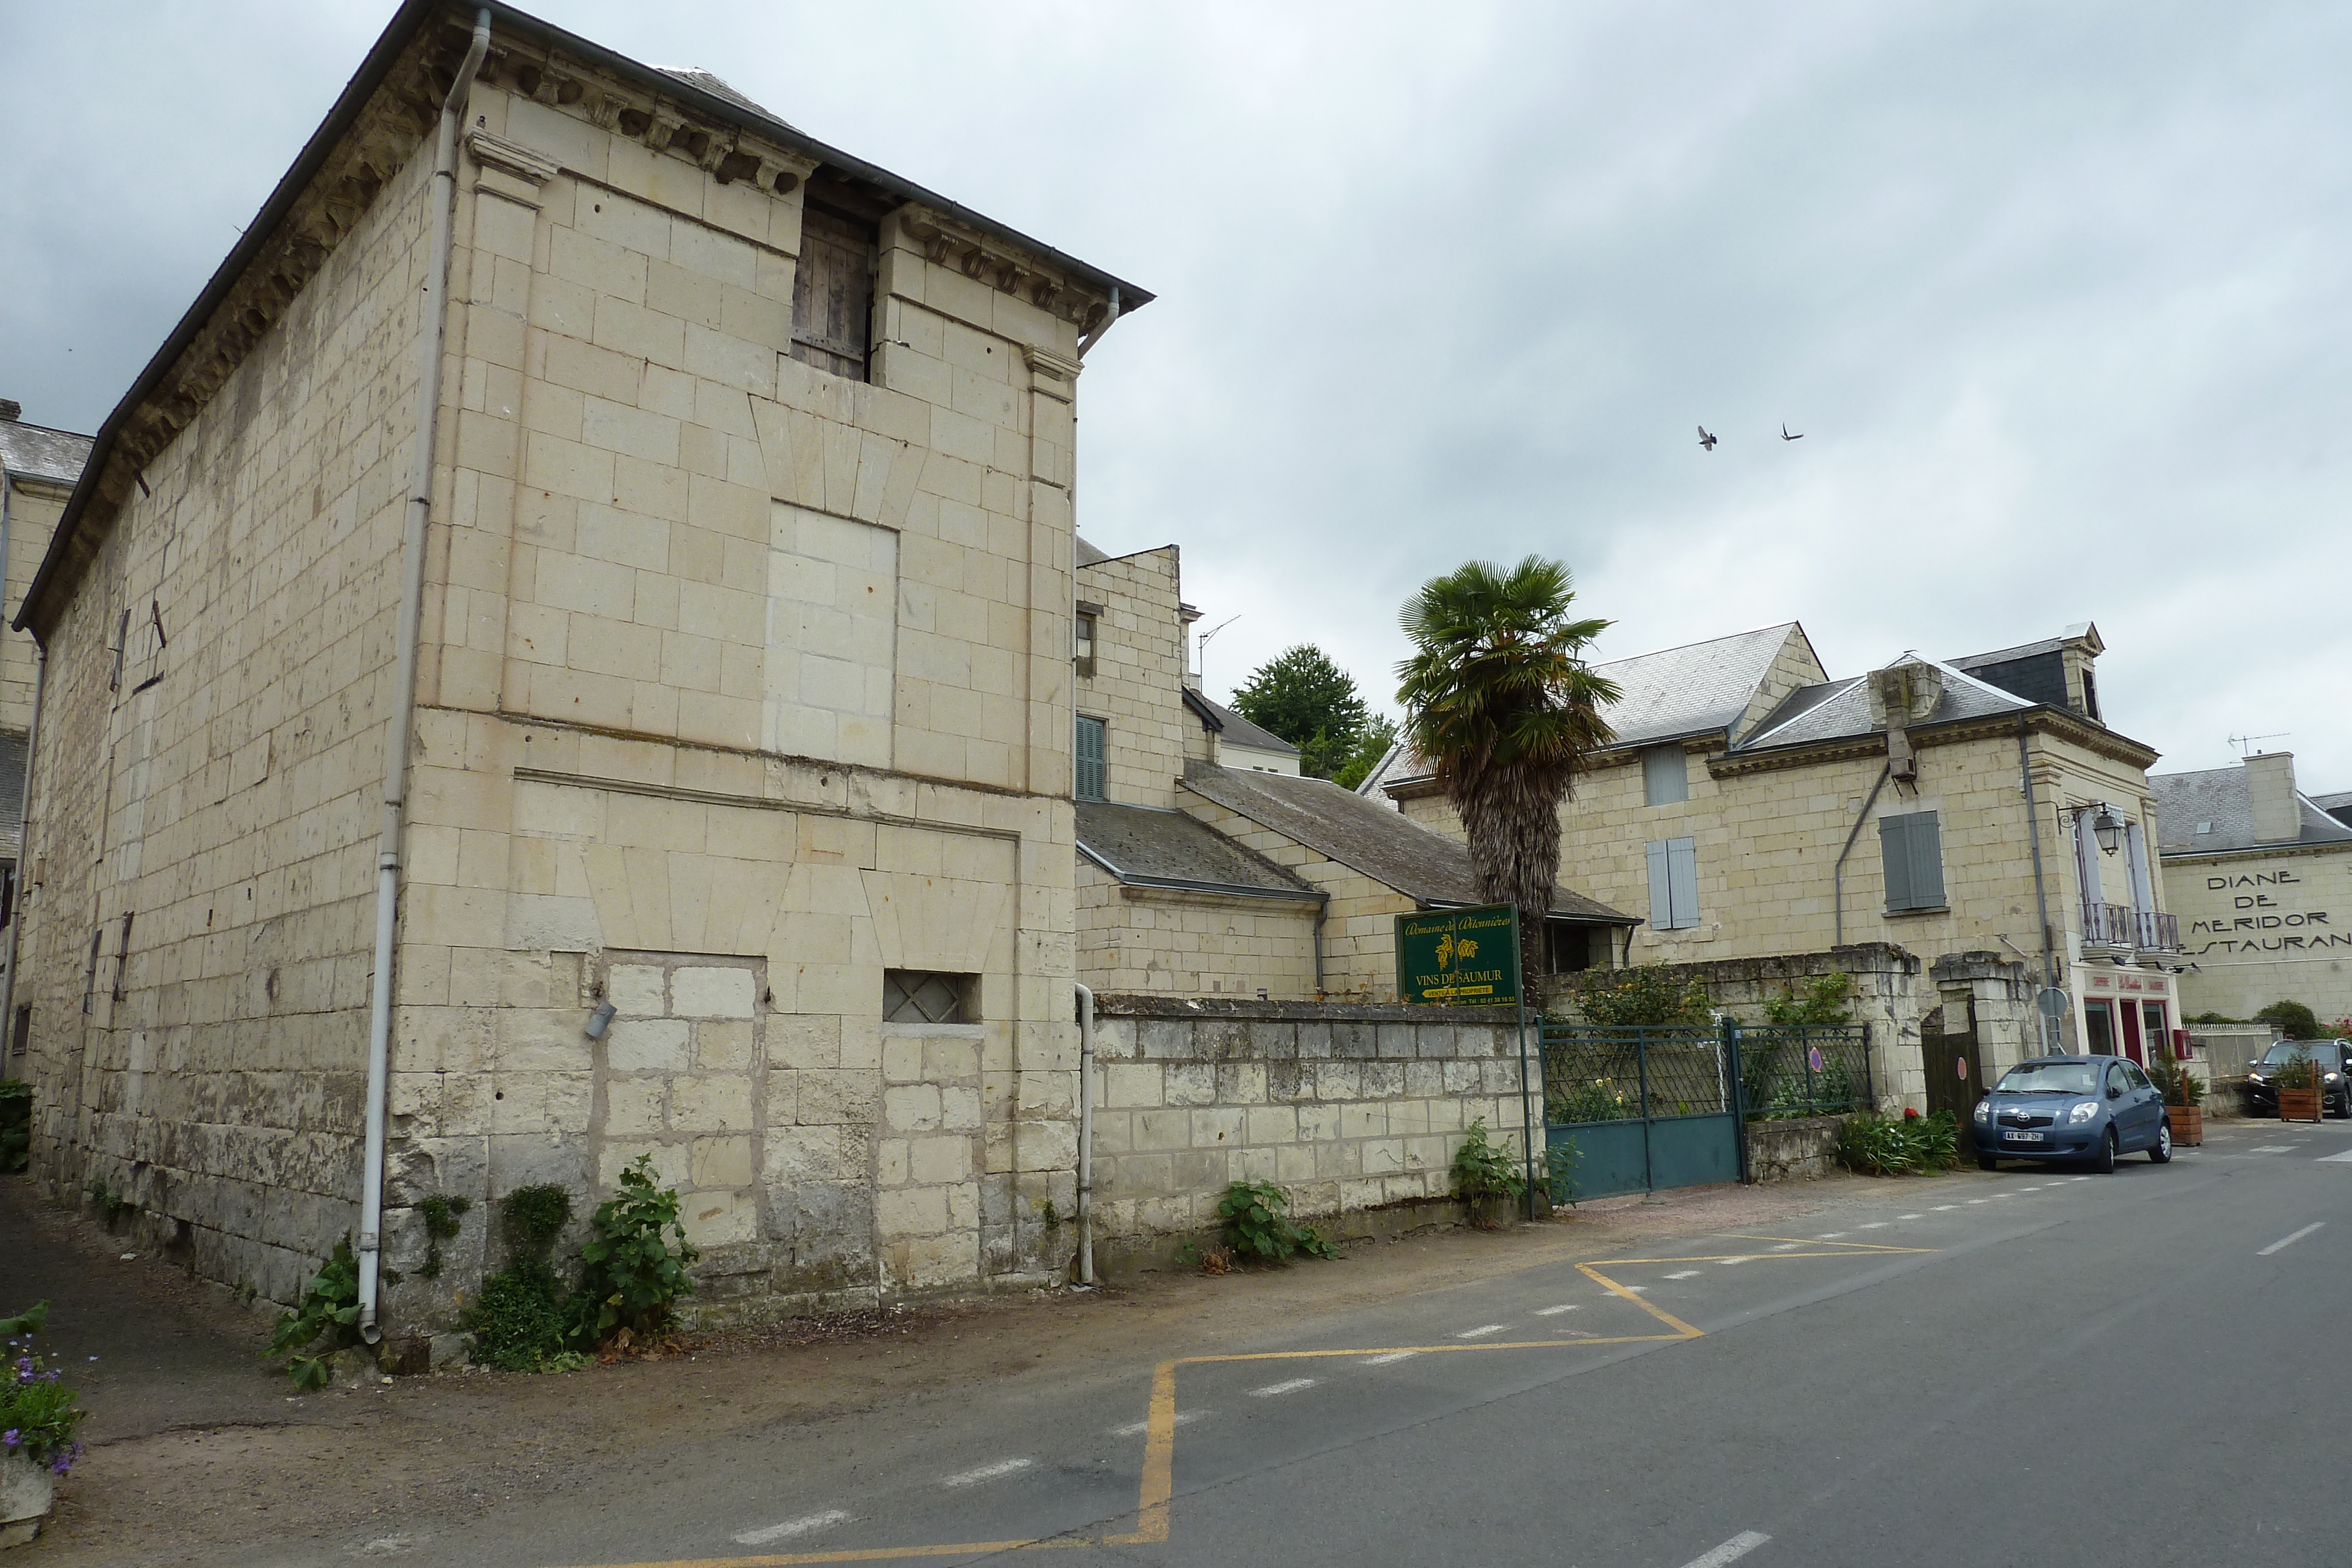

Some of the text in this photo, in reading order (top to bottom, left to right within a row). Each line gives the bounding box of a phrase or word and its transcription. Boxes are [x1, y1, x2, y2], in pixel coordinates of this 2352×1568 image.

[2207, 871, 2300, 890] DIANE
[2234, 894, 2277, 909] DE
[1405, 922, 1445, 936] Domaine
[2191, 912, 2329, 934] MERIDOR
[2176, 932, 2352, 955] ESTAURAN
[1416, 969, 1503, 986] VINS DE SAUMUR
